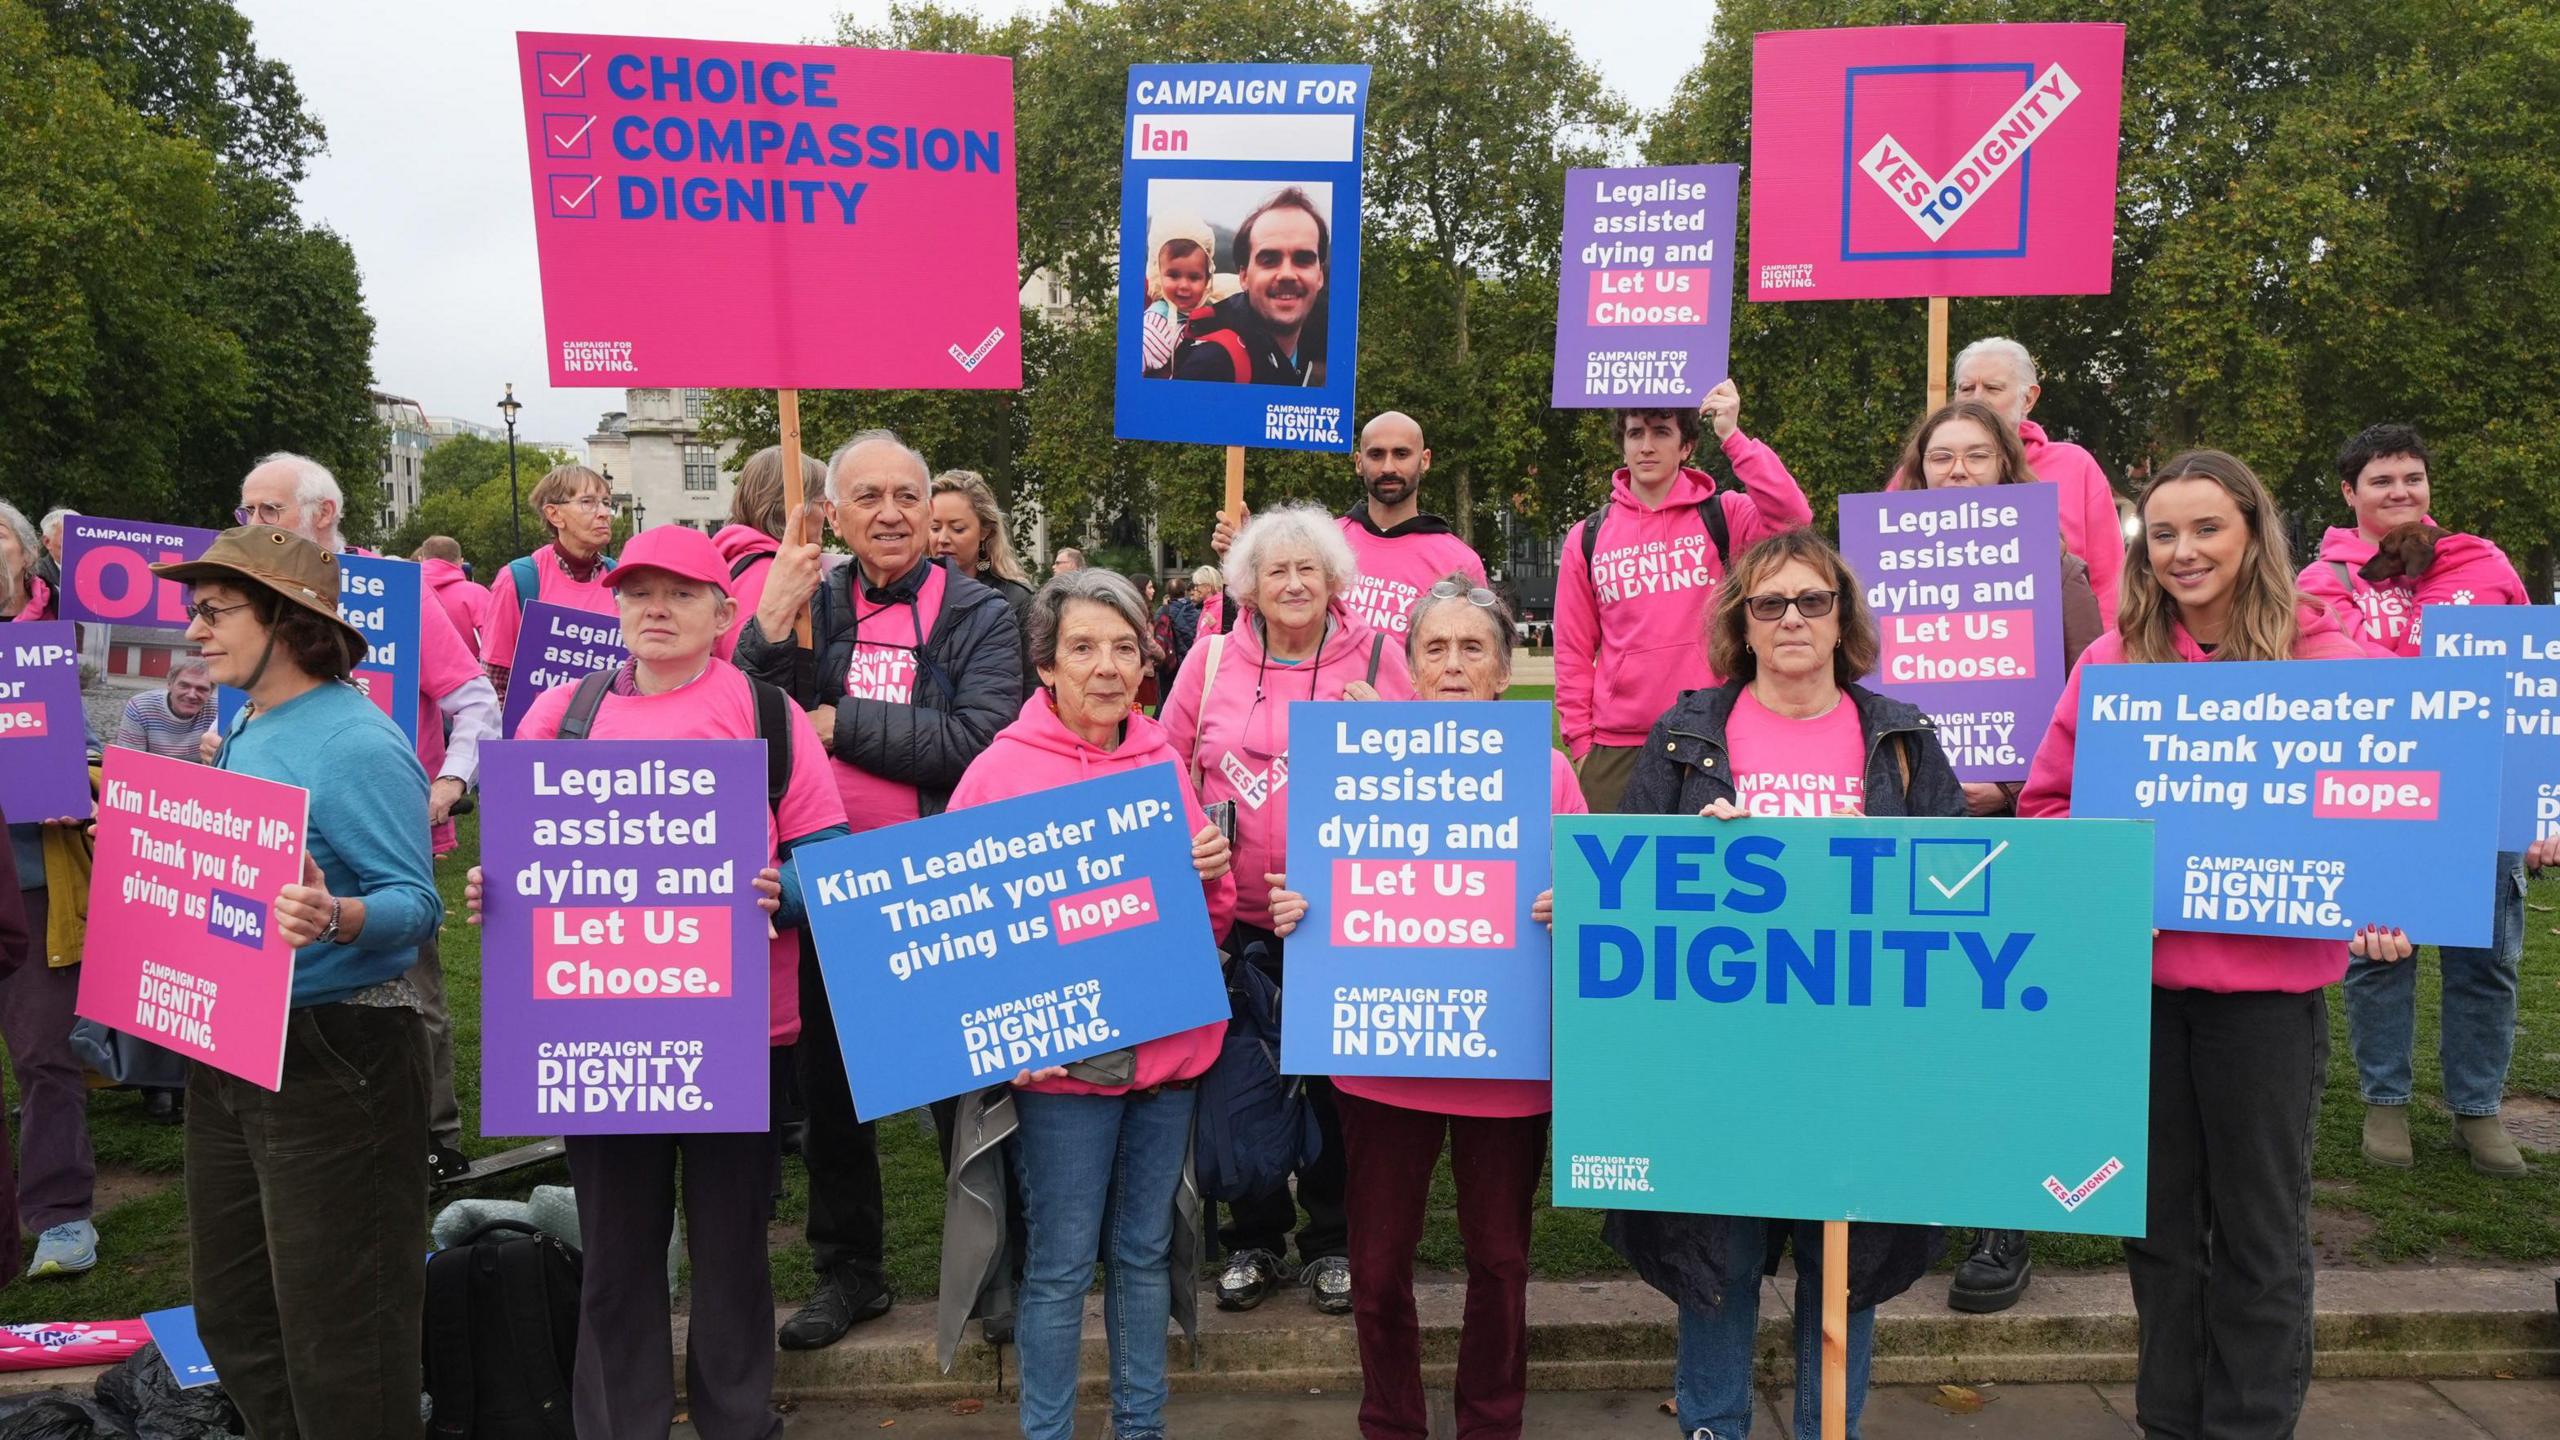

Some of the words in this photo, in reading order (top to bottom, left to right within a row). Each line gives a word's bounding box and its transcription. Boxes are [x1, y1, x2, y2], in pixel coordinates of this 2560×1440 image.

[608, 54, 837, 107] CHOICE
[1137, 80, 1287, 104] CAMPAIGN
[1297, 81, 1357, 104] FOR
[613, 116, 999, 173] COMPASSION
[1141, 123, 1188, 152] Ian
[1873, 146, 1930, 207] YES
[618, 176, 867, 224] DIGNITY
[1597, 179, 1706, 207] Legalise
[1594, 209, 1704, 233] assisted
[1582, 241, 1654, 268] dying
[1665, 240, 1713, 262] and
[1602, 272, 1644, 293] Let
[1656, 272, 1689, 292] Us
[1761, 269, 1813, 280] DIGNITY
[1762, 280, 1773, 288] IN
[1775, 279, 1816, 288] DYING.
[1596, 303, 1700, 323] Choose.
[564, 348, 631, 361] DIGNITY
[565, 360, 580, 370] IN
[582, 360, 638, 372] DYING.
[952, 347, 967, 363] YES
[1588, 352, 1656, 361] CAMPAIGN
[1662, 351, 1687, 360] FOR
[1587, 361, 1686, 378] DIGNITY
[1586, 379, 1608, 394] IN
[1614, 378, 1691, 394] DYING.
[1267, 404, 1317, 414] CAMPAIGN
[1321, 408, 1339, 416] FOR
[1267, 413, 1339, 429] DIGNITY
[1266, 427, 1282, 439] IN
[1286, 428, 1343, 443] DYING.
[1879, 502, 2018, 537] Legalise
[77, 527, 151, 543] CAMPAIGN
[156, 535, 183, 546] FOR
[1592, 541, 1667, 565] CAMPAIGN
[1674, 534, 1705, 549] FOR
[1594, 545, 1706, 586] DIGNITY
[1880, 538, 2019, 570] assisted
[74, 546, 190, 623] OL
[1339, 585, 1415, 613] NITY
[1388, 580, 1418, 597] FOR
[1598, 582, 1620, 604] IN
[1623, 566, 1716, 599] DYING.
[1868, 580, 1959, 612] dying
[1974, 574, 2033, 602] and
[550, 616, 627, 649] Legali
[1896, 616, 1949, 643] Let
[1965, 614, 2008, 640] Us
[16, 646, 73, 666] MP:
[852, 650, 893, 665] PAIGN
[2436, 633, 2507, 657] Kim
[848, 661, 918, 686] GNIT
[1892, 654, 2026, 680] Choose.
[0, 682, 25, 699] or
[1982, 712, 2014, 723] FOR
[2093, 694, 2161, 720] Kim
[2177, 692, 2394, 721] Leadbeater
[2411, 691, 2490, 719] MP:
[0, 712, 42, 734] pe.
[1935, 724, 2015, 746] NITY
[1337, 721, 1503, 761] Legalise
[1942, 745, 2025, 766] YING.
[2144, 735, 2256, 761] Thank
[2272, 741, 2342, 768] you
[2359, 734, 2417, 763] for
[534, 760, 715, 803] Legalise
[1225, 757, 1252, 790] YES
[1335, 768, 1502, 801] assisted
[1735, 773, 1836, 792] MPAIGN
[1736, 792, 1862, 817] IGNIT
[2136, 774, 2247, 809] giving
[2264, 783, 2306, 804] us
[2323, 777, 2431, 812] hope.
[106, 780, 142, 813] Kim
[149, 790, 252, 841] Leadbeater
[258, 818, 295, 854] MP:
[534, 810, 715, 845] assisted
[1319, 815, 1429, 856] dying
[1446, 817, 1518, 849] and
[130, 829, 186, 870] Thank
[192, 849, 226, 881] you
[231, 855, 260, 890] for
[817, 870, 891, 905] Kim
[902, 818, 1095, 886] Leadbeater
[1107, 800, 1172, 834] MP:
[2187, 856, 2294, 873] CAMPAIGN
[2303, 861, 2344, 875] FOR
[517, 860, 637, 903] dying
[656, 860, 733, 894] and
[1351, 863, 1415, 895] Let
[1434, 864, 1485, 896] Us
[1572, 834, 1787, 914] YES
[2184, 871, 2344, 900] DIGNITY
[123, 873, 178, 918] giving
[184, 893, 206, 919] us
[211, 894, 262, 938] hope.
[881, 884, 994, 931] Thank
[1003, 869, 1067, 908] you
[1077, 854, 1124, 884] for
[2183, 896, 2218, 919] IN
[2226, 898, 2352, 927] DYING.
[554, 911, 624, 944] Let
[644, 911, 699, 944] Us
[889, 927, 997, 980] giving
[1008, 917, 1048, 944] us
[1059, 894, 1150, 931] hope.
[1344, 910, 1504, 944] Choose.
[142, 960, 194, 993] CAMPAIGN
[197, 978, 218, 998] FOR
[547, 960, 720, 994] Choose.
[1578, 924, 2048, 1012] DIGNITY.
[139, 977, 216, 1023] DIGNITY
[961, 991, 1057, 1027] CAMPAIGN
[1064, 979, 1100, 1000] FOR
[1335, 987, 1439, 1003] CAMPAIGN
[1448, 989, 1487, 1003] FOR
[136, 1001, 154, 1028] IN
[156, 1008, 217, 1051] DYING.
[963, 994, 1101, 1053] DIGNITY
[1334, 1003, 1486, 1030] DIGNITY
[539, 1042, 651, 1057] CAMPAIGN
[661, 1041, 702, 1055] FOR
[969, 1051, 1005, 1076] IN
[1009, 1018, 1120, 1066] DYING.
[1333, 1030, 1367, 1055] IN
[1376, 1031, 1496, 1057] DYING.
[539, 1057, 702, 1085] DIGNITY
[538, 1087, 575, 1113] IN
[585, 1085, 713, 1112] DYING.
[1571, 1154, 1627, 1164] CAMPAIGN
[1571, 1163, 1649, 1180] DIGNITY
[1571, 1176, 1591, 1189] IN
[1592, 1177, 1655, 1192] DYING.
[2048, 1178, 2068, 1200] YES
